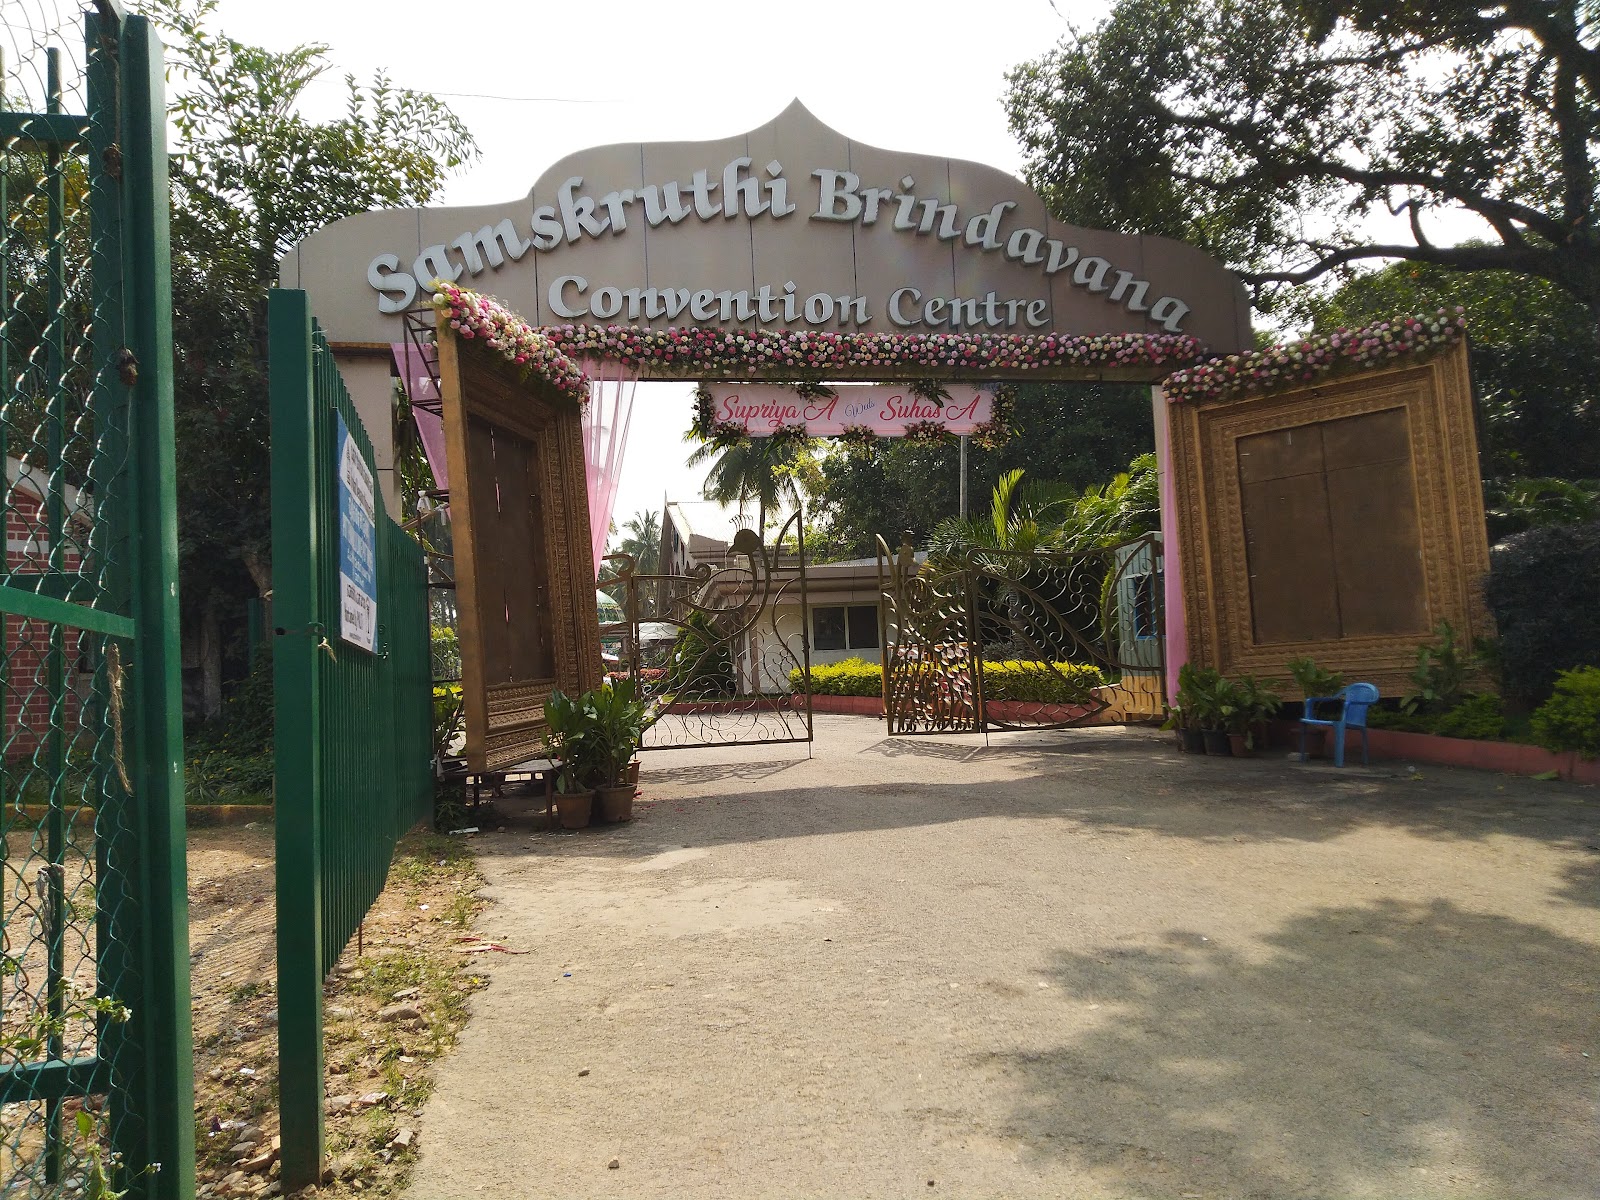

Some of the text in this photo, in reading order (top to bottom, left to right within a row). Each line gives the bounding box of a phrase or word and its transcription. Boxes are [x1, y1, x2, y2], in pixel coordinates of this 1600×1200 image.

[367, 156, 1192, 335] Samskruthi Brindavana
[548, 275, 1051, 328] Convention Centre
[714, 395, 801, 428] Supriya
[803, 395, 840, 421] A
[879, 395, 941, 421] Suhas
[945, 394, 983, 421] A
